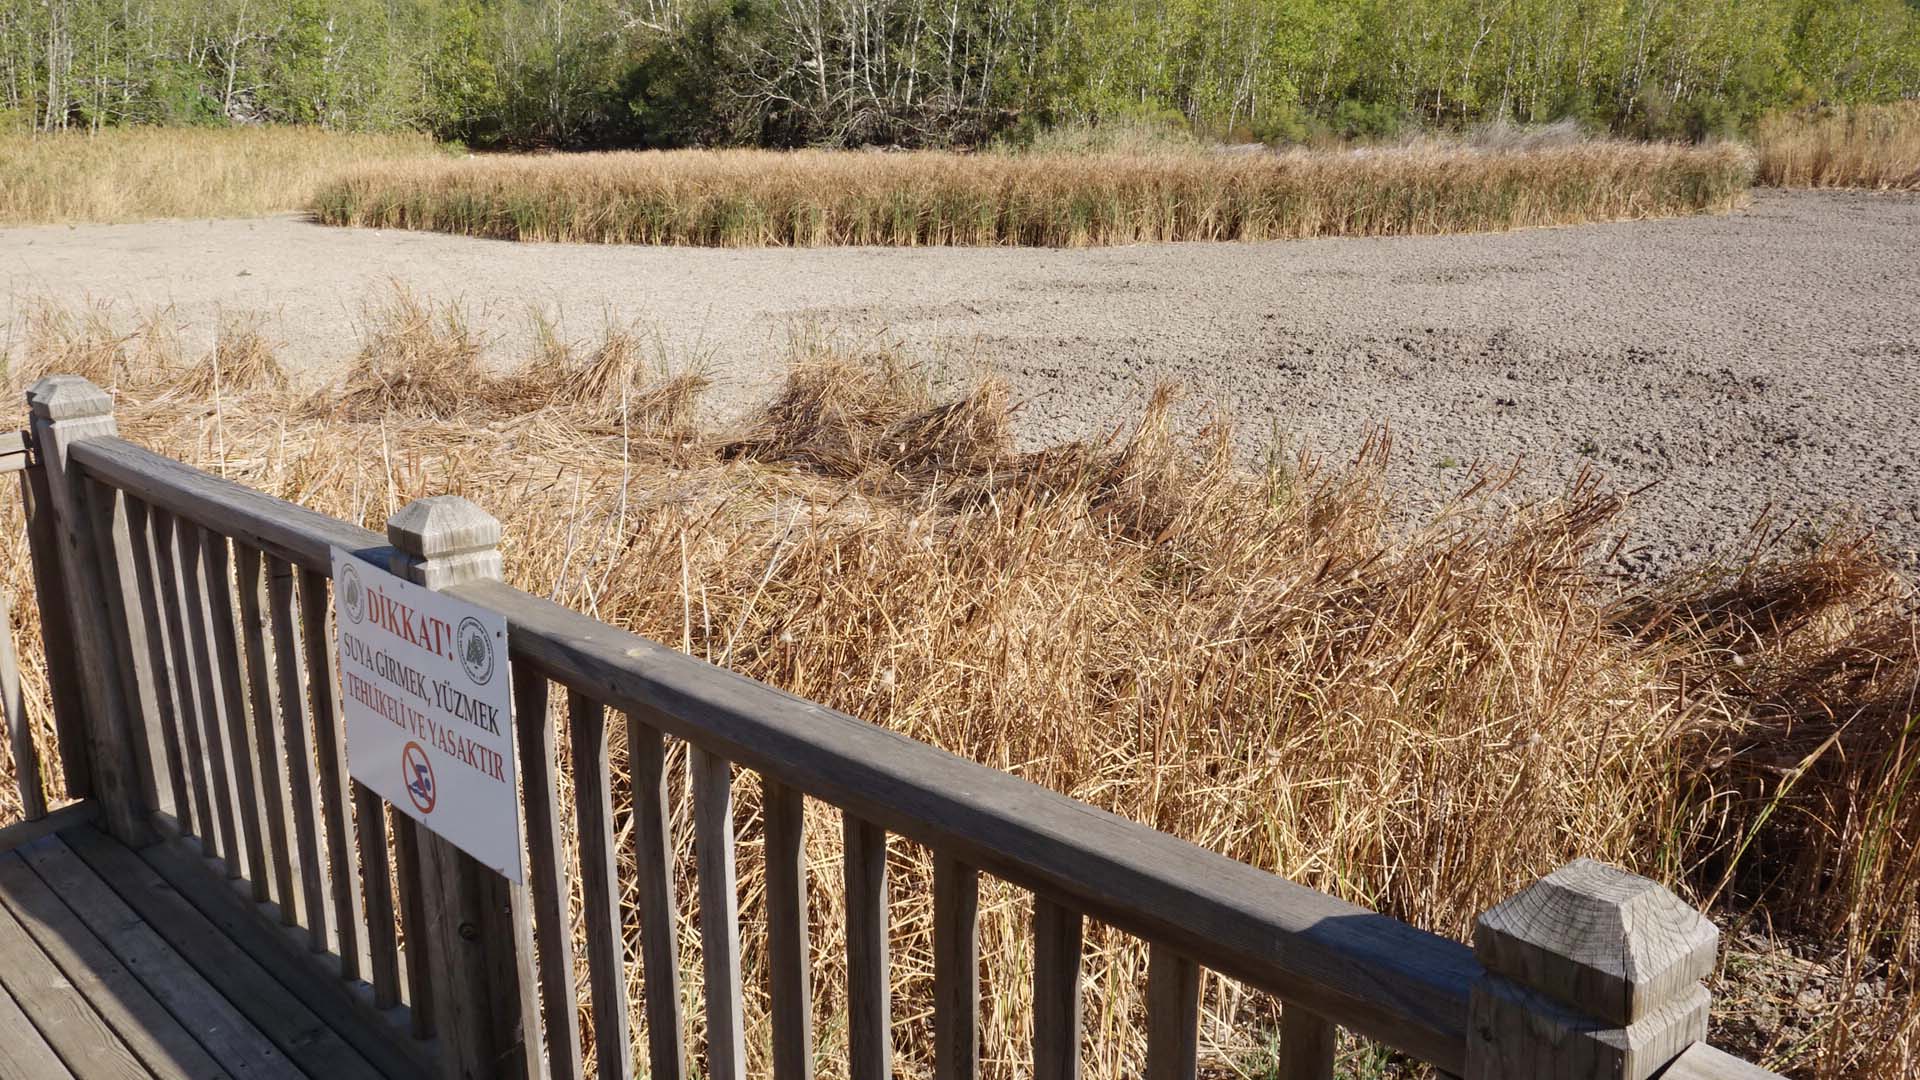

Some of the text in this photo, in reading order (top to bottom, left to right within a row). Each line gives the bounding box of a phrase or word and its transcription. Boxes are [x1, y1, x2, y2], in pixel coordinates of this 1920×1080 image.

[367, 584, 453, 661] DİKKAT!
[344, 632, 374, 671] SUYA
[375, 649, 431, 707] GİRMEK,
[432, 680, 500, 736] YÜZMEK
[346, 671, 506, 783] TEHLİKELİ VE YASAKTIR
